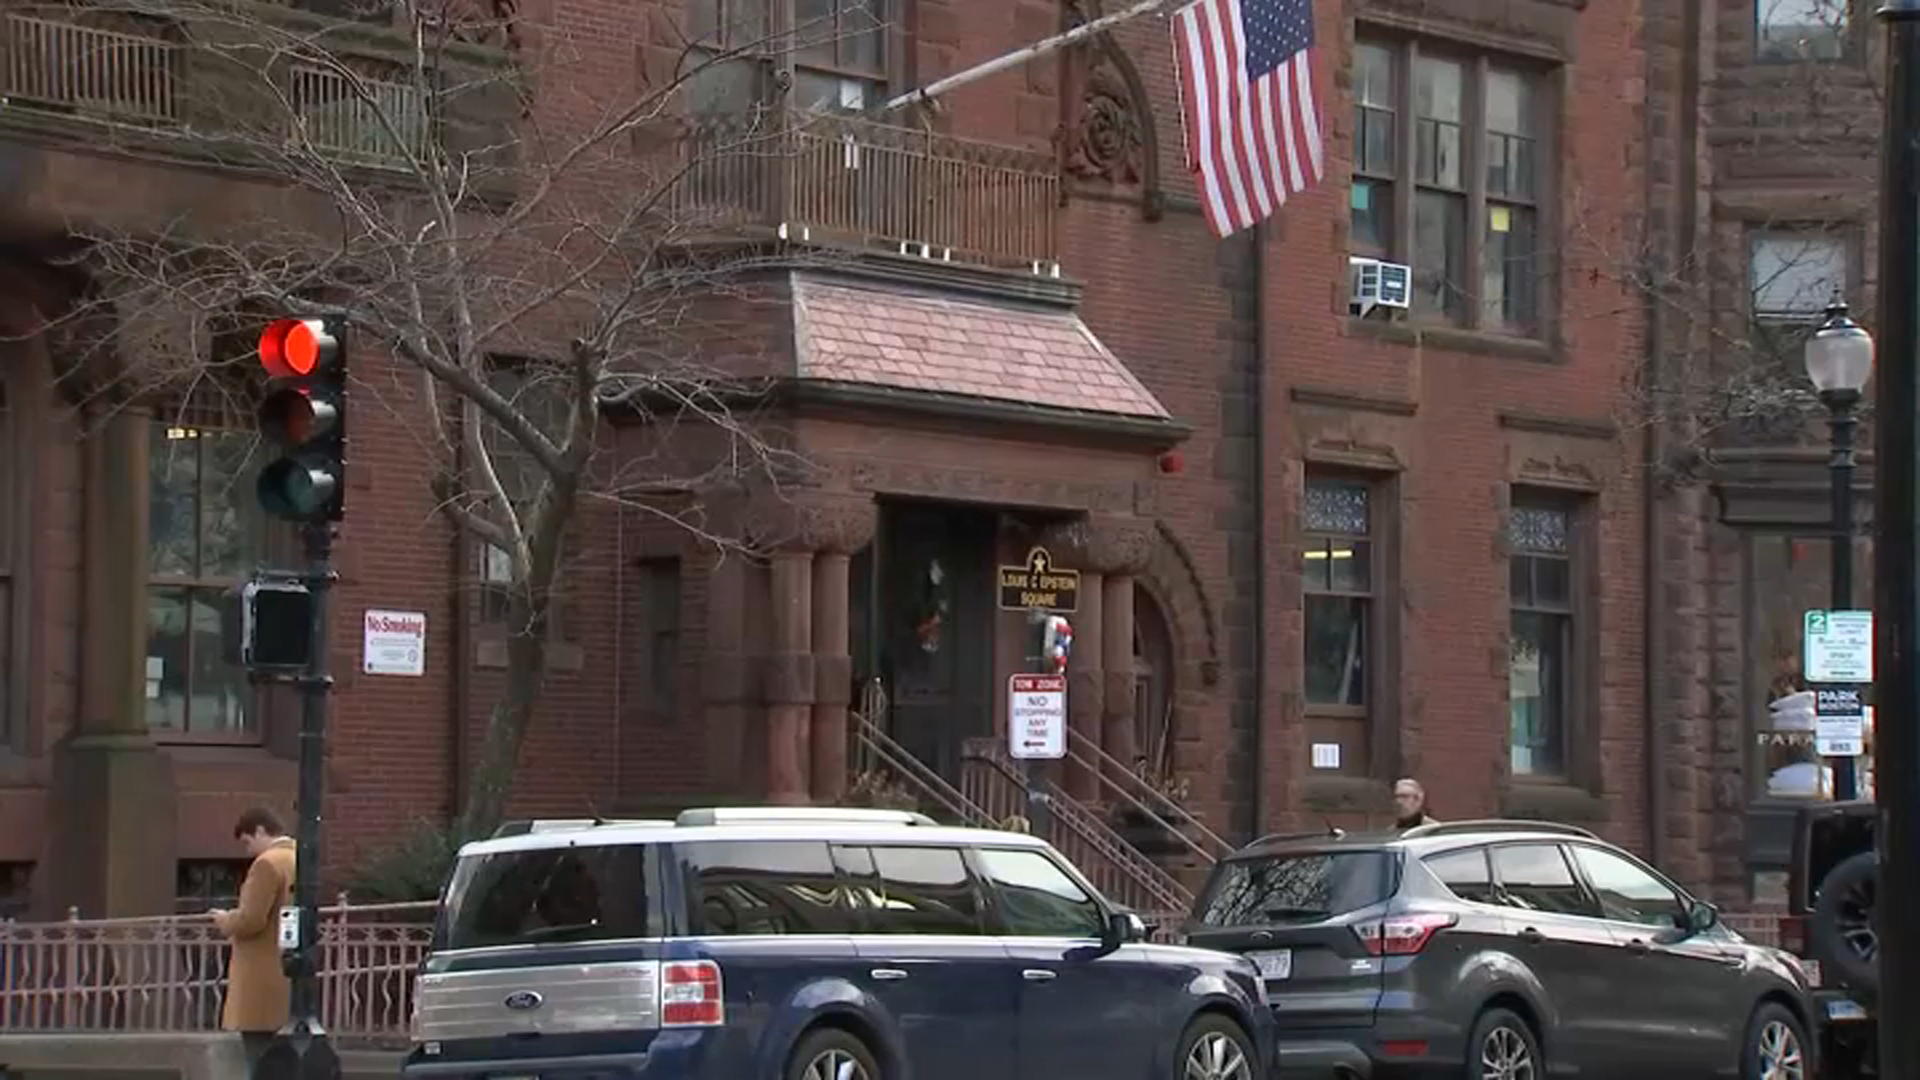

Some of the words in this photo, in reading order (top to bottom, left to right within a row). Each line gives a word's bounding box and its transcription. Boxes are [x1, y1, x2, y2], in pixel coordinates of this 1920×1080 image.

[1040, 576, 1076, 590] EPSTEIN
[1021, 592, 1057, 607] SQUARE
[368, 616, 381, 632] No
[382, 616, 422, 638] Smoking
[1810, 615, 1825, 629] 2
[1015, 680, 1034, 689] TOW
[1036, 680, 1063, 689] ZONE
[1028, 696, 1049, 706] NO
[1818, 691, 1859, 701] PARK
[1015, 708, 1062, 717] STOPPING
[1029, 719, 1047, 727] ANY
[1026, 729, 1048, 737] TIME
